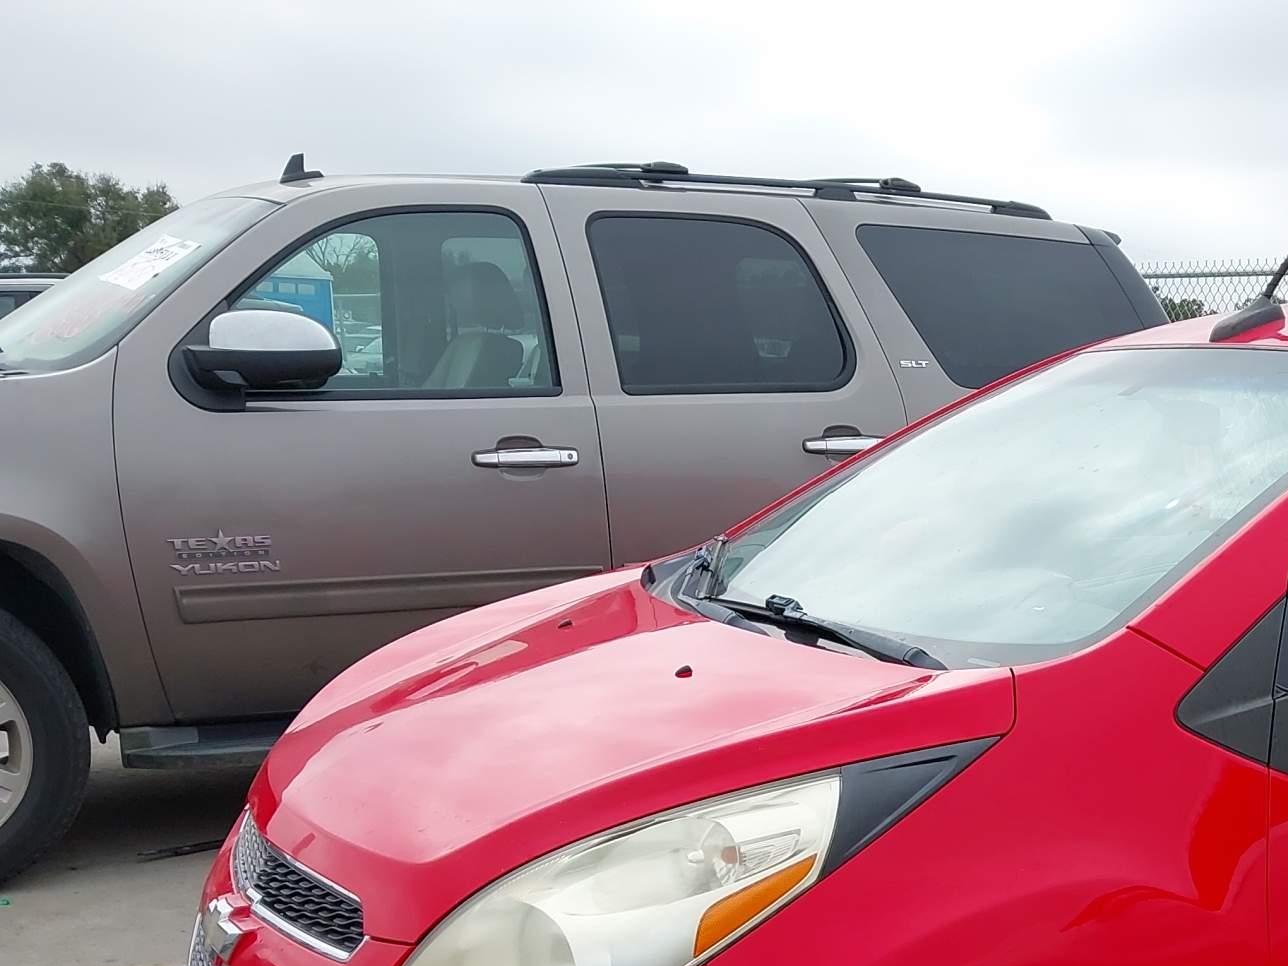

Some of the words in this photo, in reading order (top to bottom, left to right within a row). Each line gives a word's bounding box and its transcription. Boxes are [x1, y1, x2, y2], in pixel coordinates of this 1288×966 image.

[899, 360, 929, 368] SLT
[166, 529, 272, 551] TEXAS
[169, 560, 281, 576] YUKON
